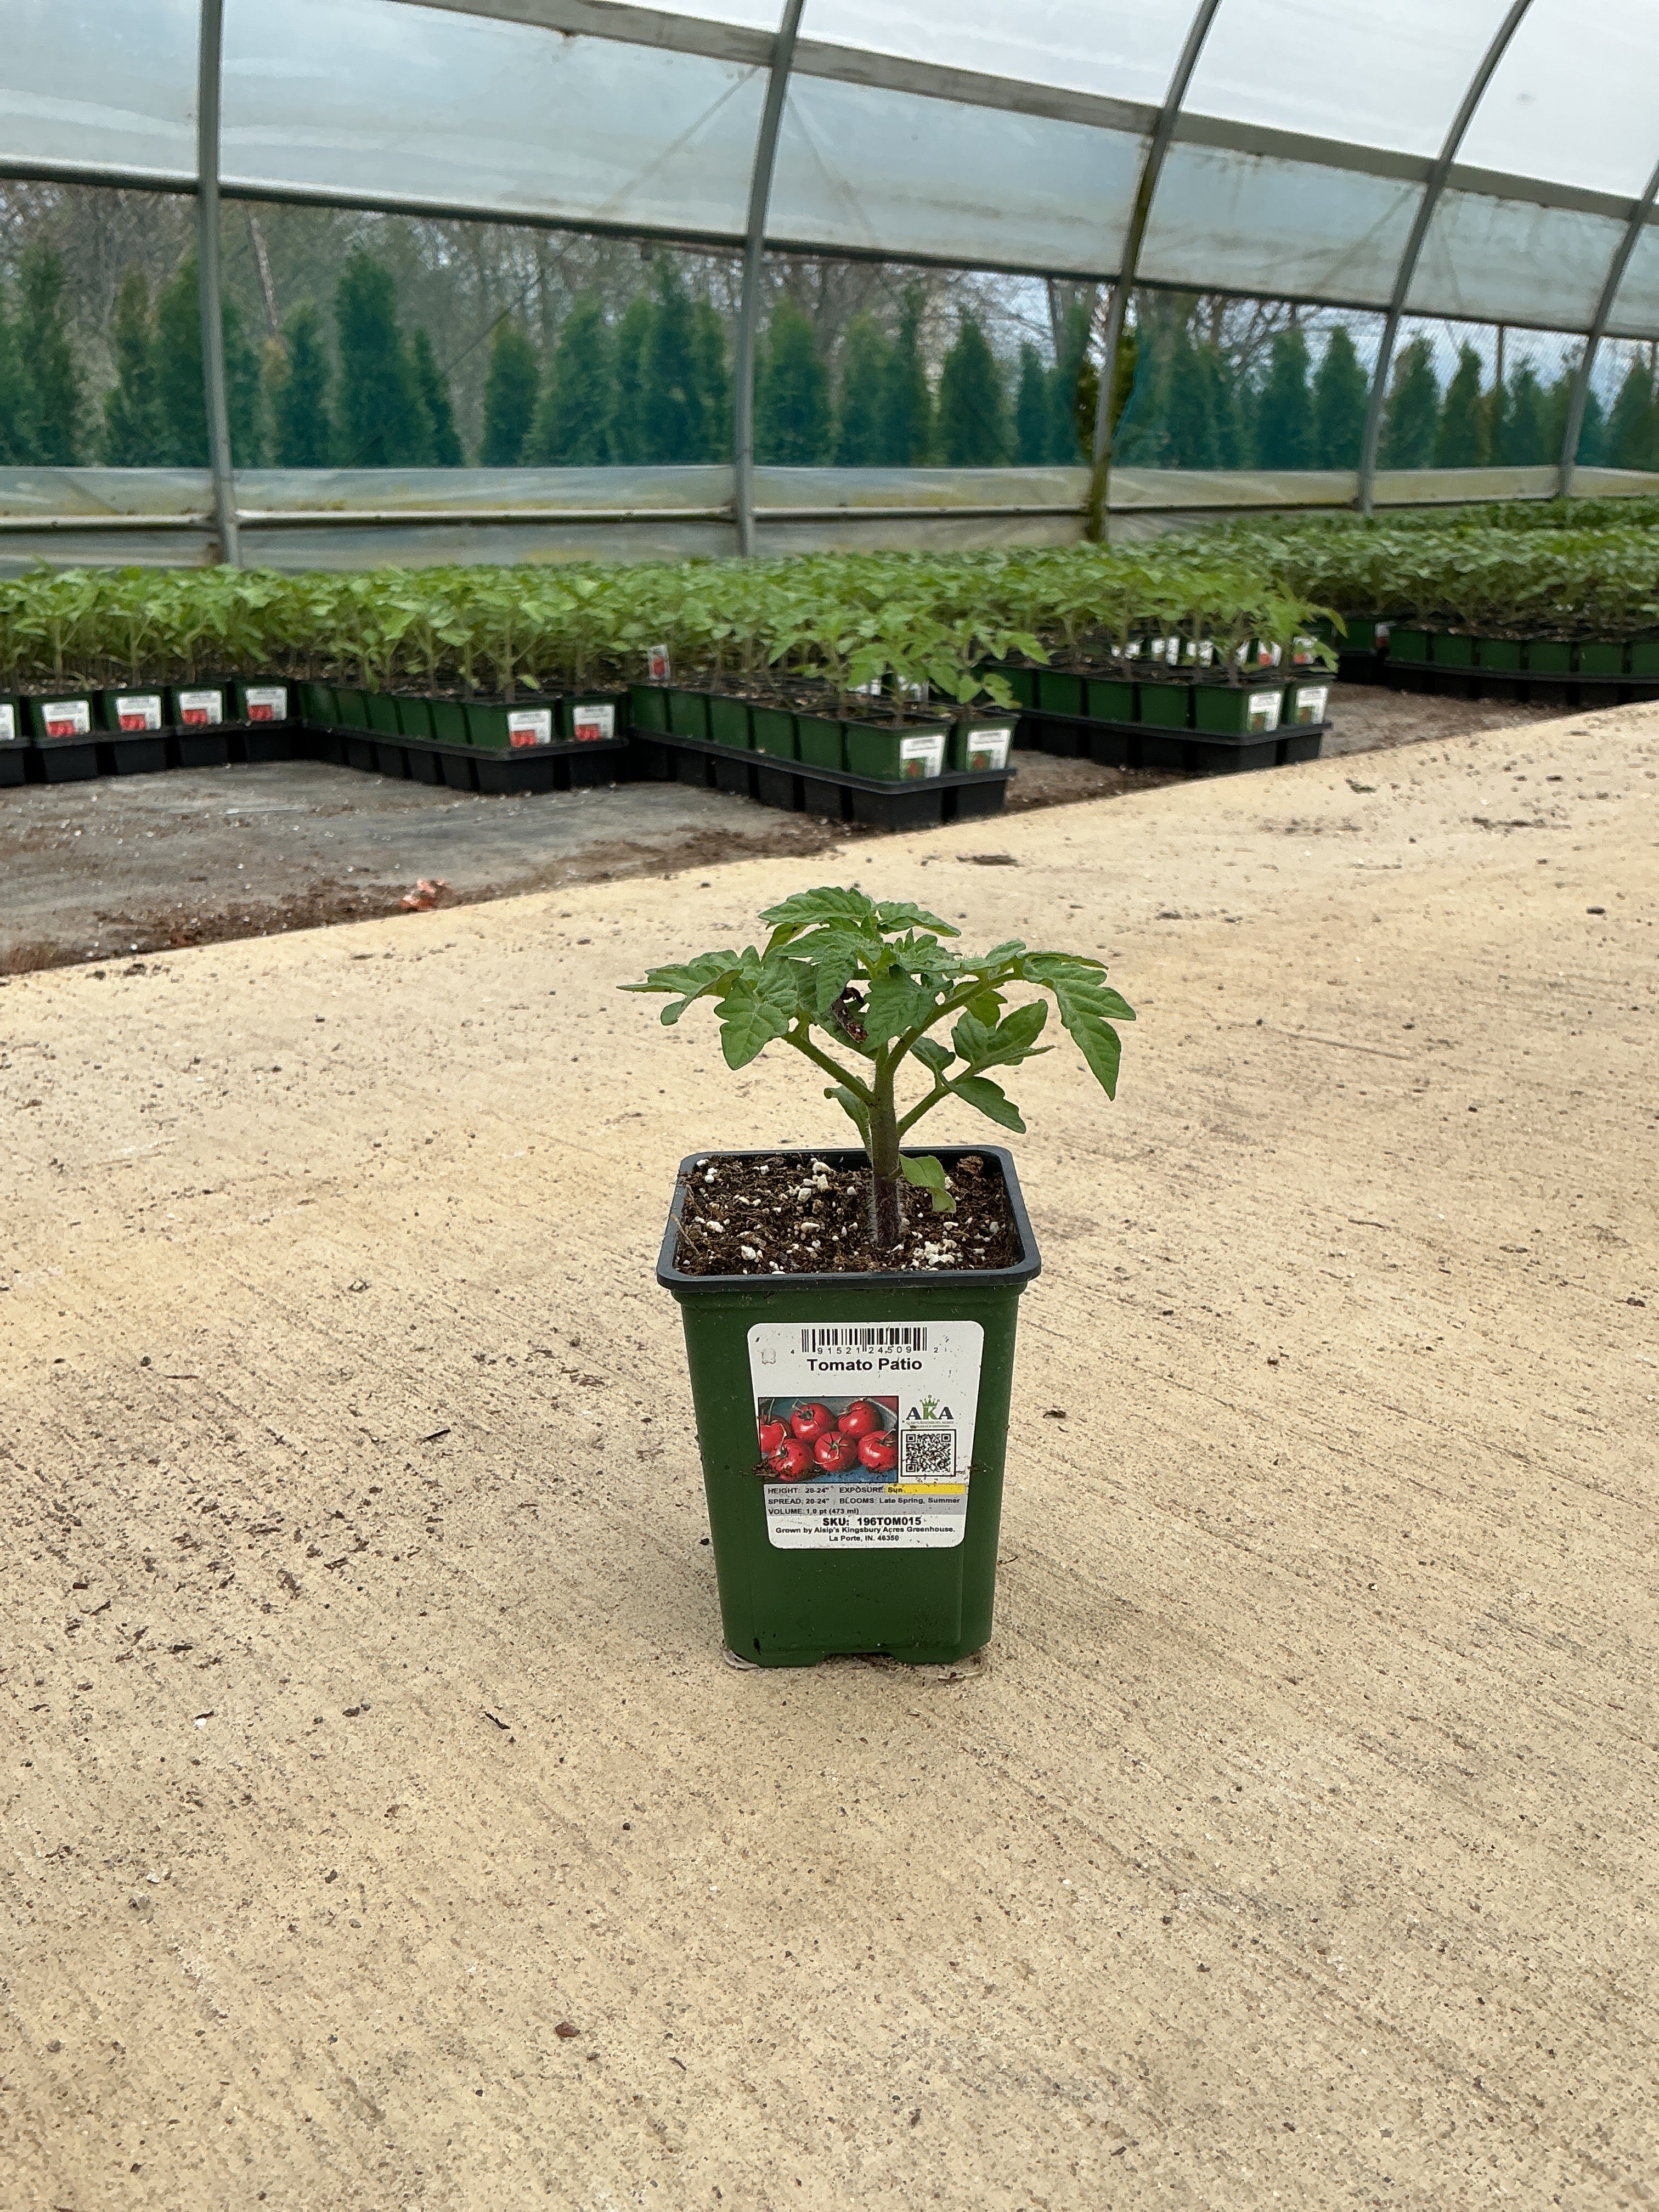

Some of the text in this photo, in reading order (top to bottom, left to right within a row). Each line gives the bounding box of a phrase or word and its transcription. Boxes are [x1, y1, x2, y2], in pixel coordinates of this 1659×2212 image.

[806, 1358, 922, 1371] Tomato Patio
[906, 1407, 954, 1420] AKA
[823, 1517, 922, 1526] SKU: 196TOM015
